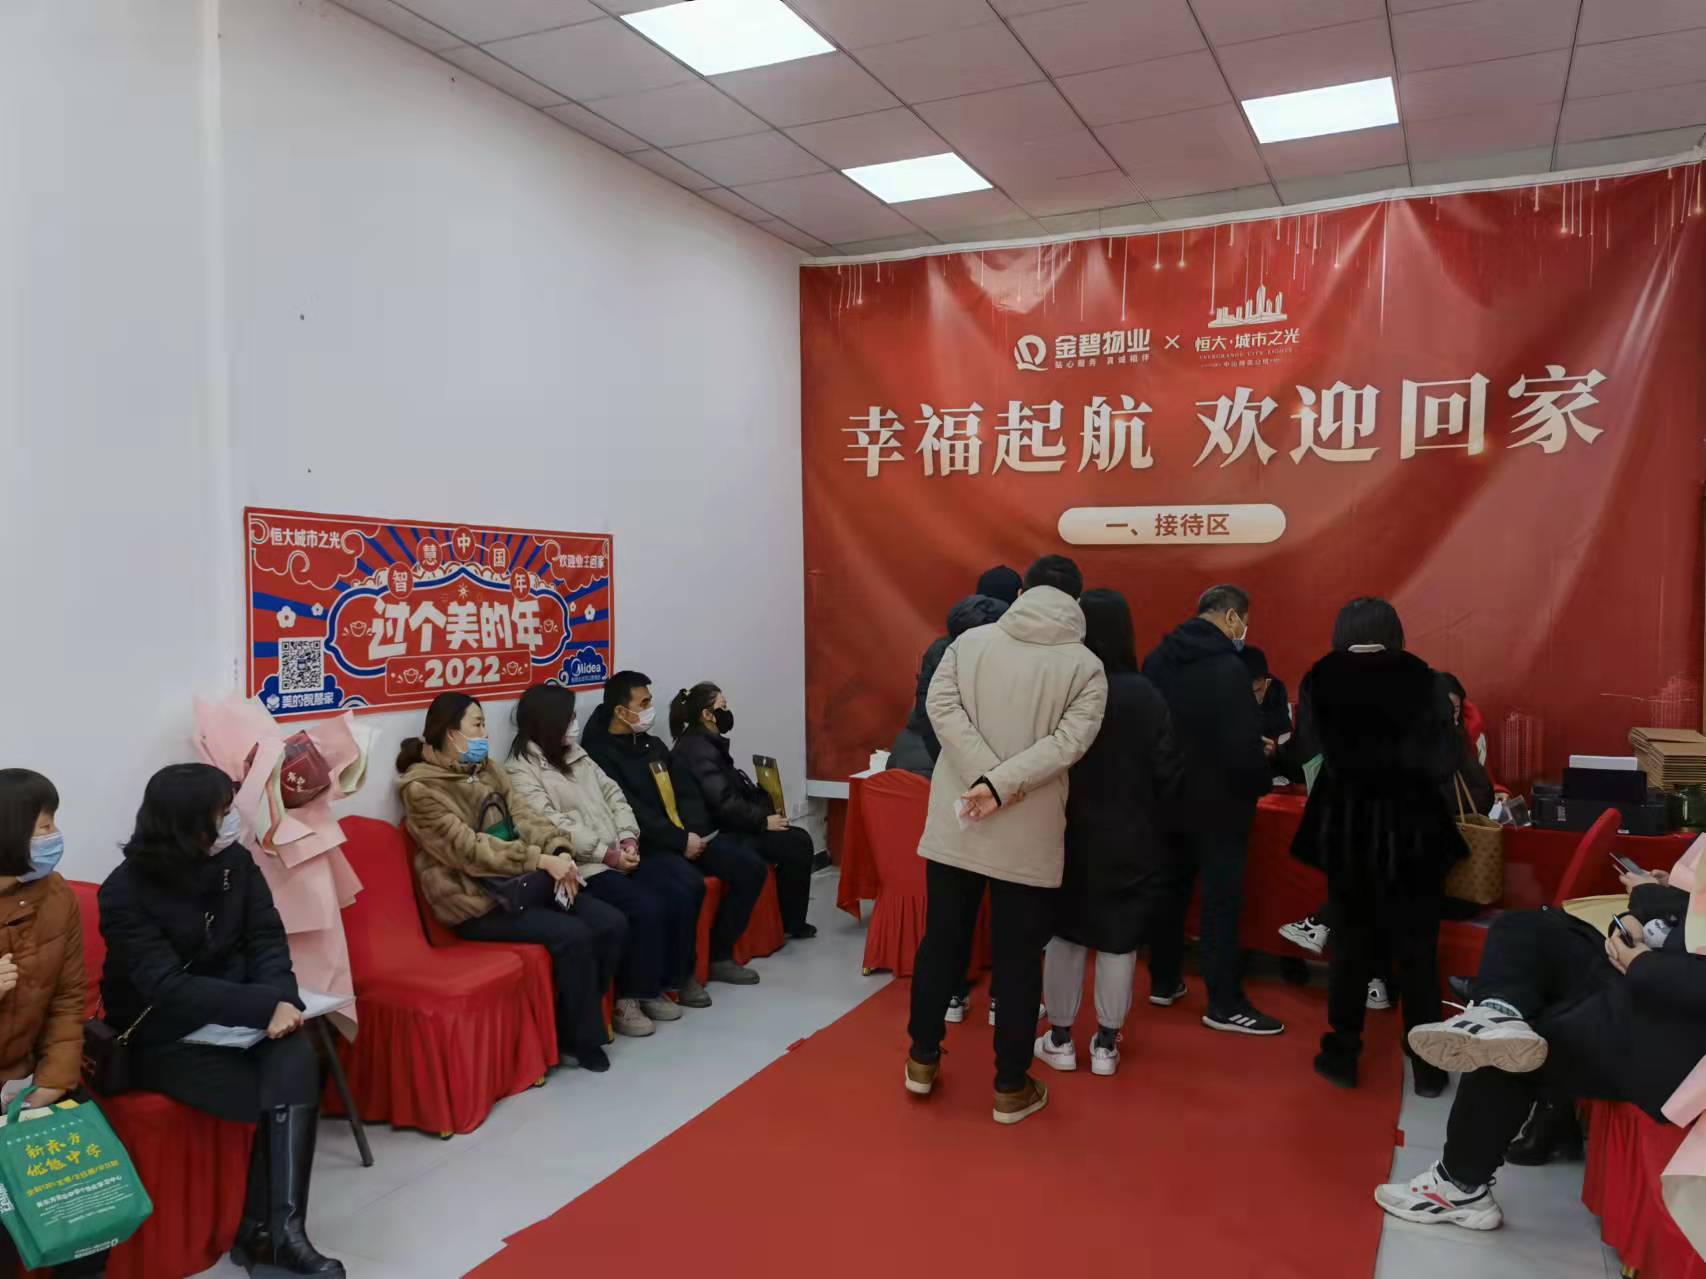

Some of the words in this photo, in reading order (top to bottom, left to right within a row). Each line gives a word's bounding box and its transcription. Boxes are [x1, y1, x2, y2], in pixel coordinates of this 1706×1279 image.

[1054, 327, 1151, 360] 金碧物业
[841, 393, 1154, 478] 幸福起航
[1192, 365, 1608, 469] 欢迎回家
[270, 527, 341, 549] 恒大城市之光
[1105, 513, 1230, 537] 一、接待区
[368, 598, 543, 660] 过个美的年
[424, 655, 501, 688] 2022
[571, 658, 602, 677] Midea
[25, 1132, 80, 1159] 新东方
